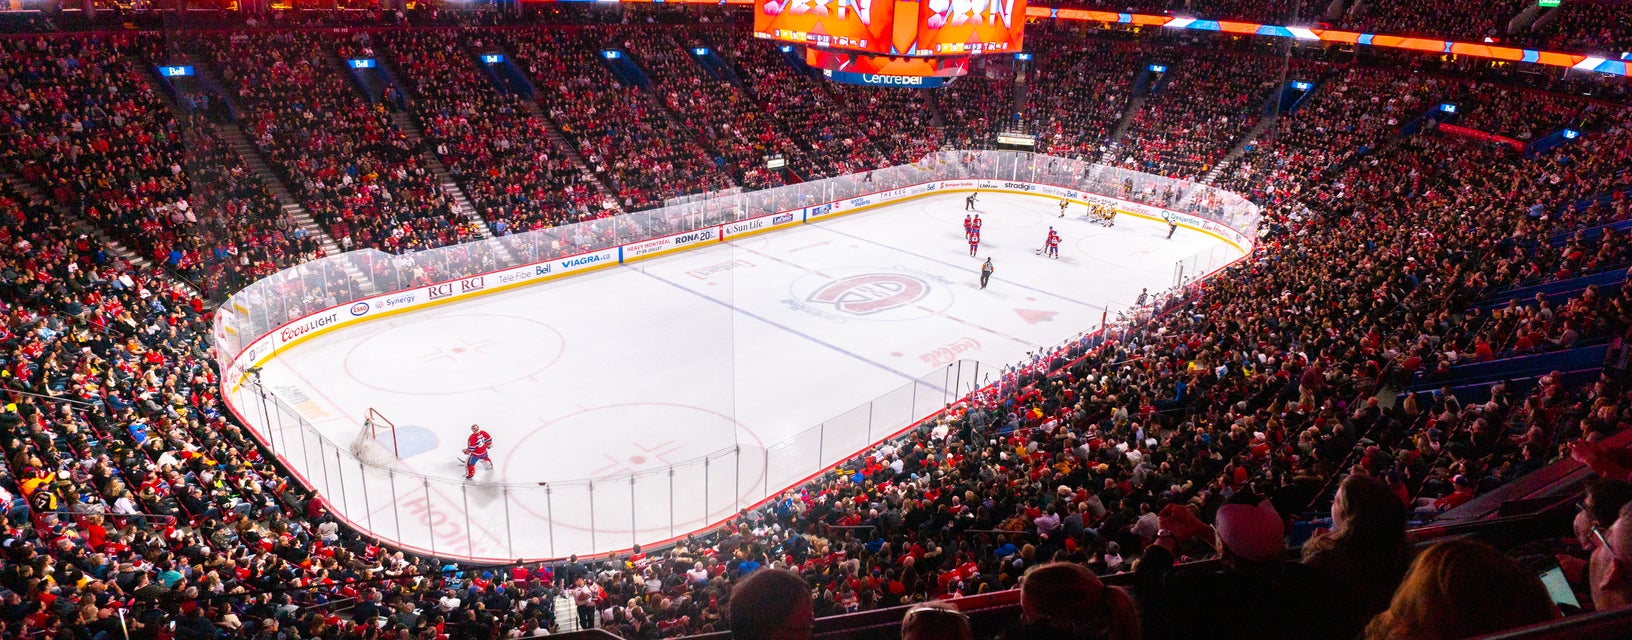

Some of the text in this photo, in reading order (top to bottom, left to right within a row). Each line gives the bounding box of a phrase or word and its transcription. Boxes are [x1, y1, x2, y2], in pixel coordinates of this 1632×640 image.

[355, 59, 368, 68] Bell
[168, 66, 186, 76] Bell
[1066, 190, 1078, 199] Bell
[1170, 212, 1200, 226] Desjardins
[733, 220, 763, 234] Sun Life
[626, 239, 671, 253] HEAVY MONTRÉAL
[675, 233, 699, 245] RONA
[562, 253, 611, 269] VIAGRA.ca
[515, 270, 531, 281] Fibe
[535, 263, 551, 276] Bell
[428, 283, 453, 299] RCI
[461, 276, 485, 293] RCI
[386, 294, 416, 308] Synergy
[353, 305, 367, 313] Esso
[280, 313, 337, 343] Coors LIGHT
